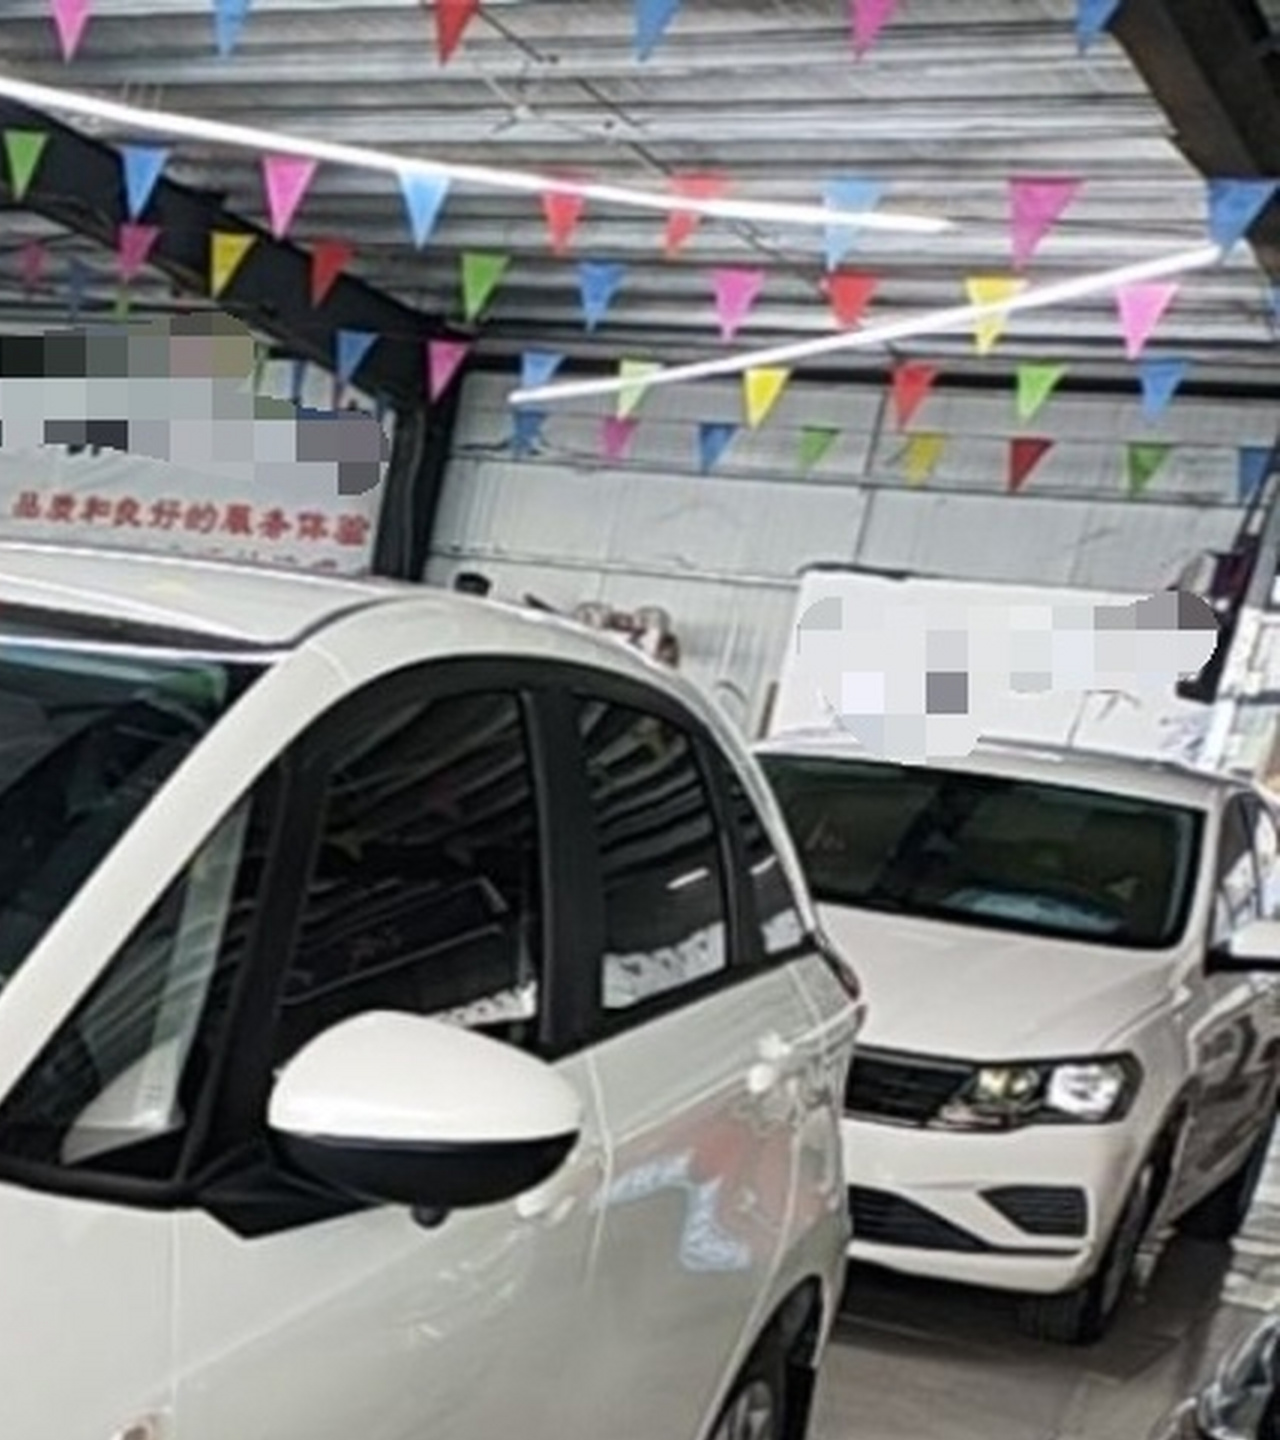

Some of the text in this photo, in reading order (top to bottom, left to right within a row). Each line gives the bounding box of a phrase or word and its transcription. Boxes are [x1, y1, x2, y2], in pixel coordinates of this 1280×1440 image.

[12, 491, 371, 547] 品质和良好的服务体验
